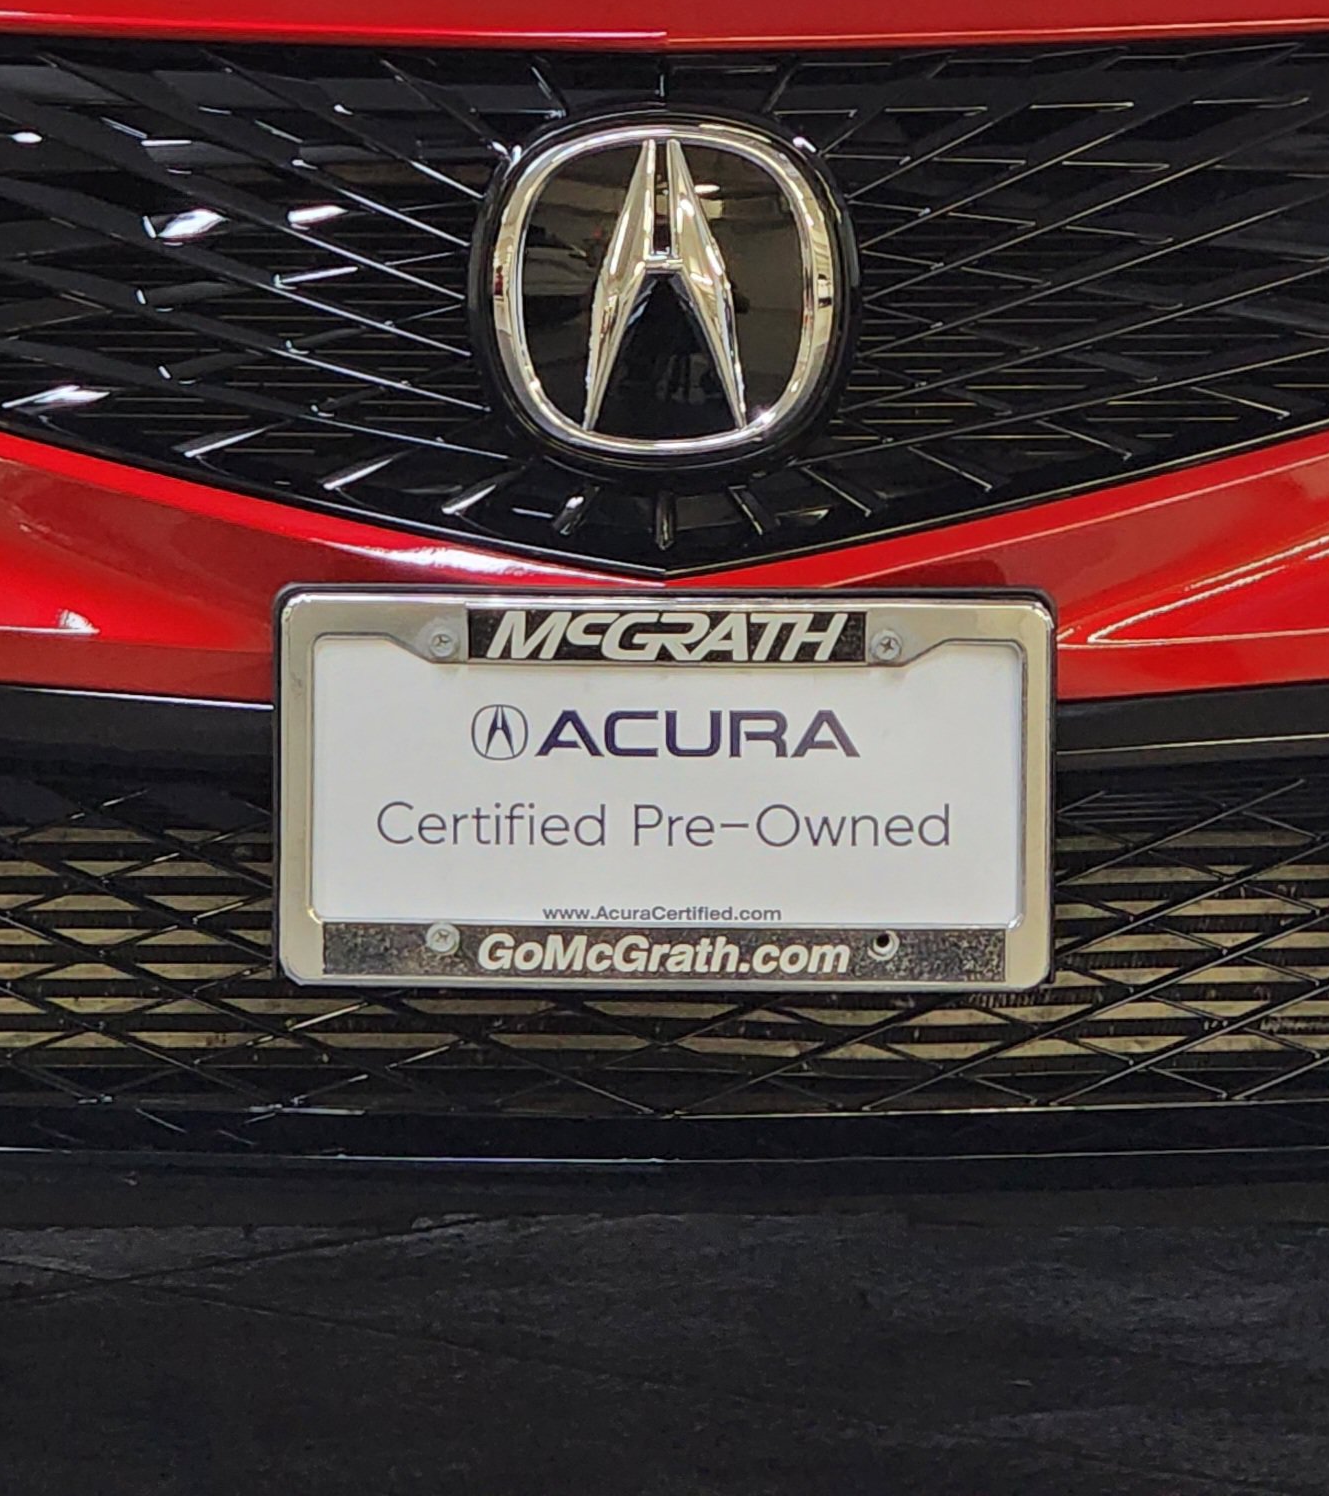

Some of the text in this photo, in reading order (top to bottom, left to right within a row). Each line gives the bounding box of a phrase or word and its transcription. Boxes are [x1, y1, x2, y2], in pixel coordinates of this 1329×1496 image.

[536, 709, 860, 758] ACURA
[375, 800, 951, 847] Certified Pre-Owned
[542, 905, 782, 924] www.AcuraCertified.com
[477, 932, 850, 974] GoMcGrath.com
